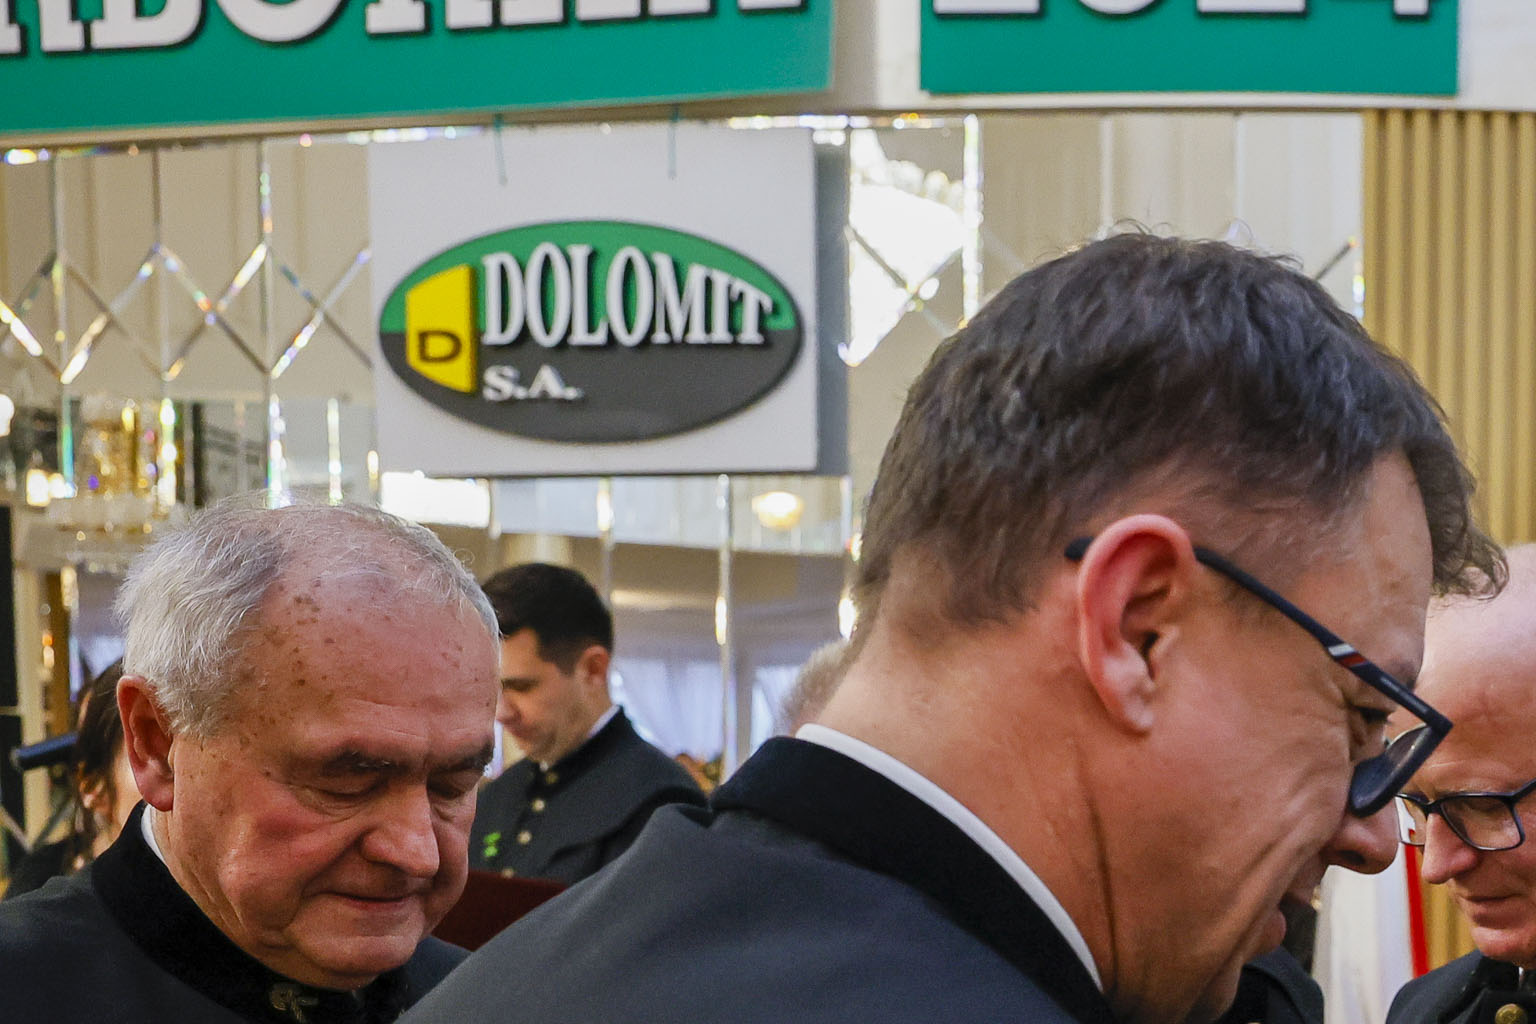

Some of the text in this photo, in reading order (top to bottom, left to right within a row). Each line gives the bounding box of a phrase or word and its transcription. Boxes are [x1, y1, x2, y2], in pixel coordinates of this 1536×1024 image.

[482, 242, 773, 348] DOLOMIT
[418, 330, 462, 363] D
[482, 364, 583, 401] S.A.
